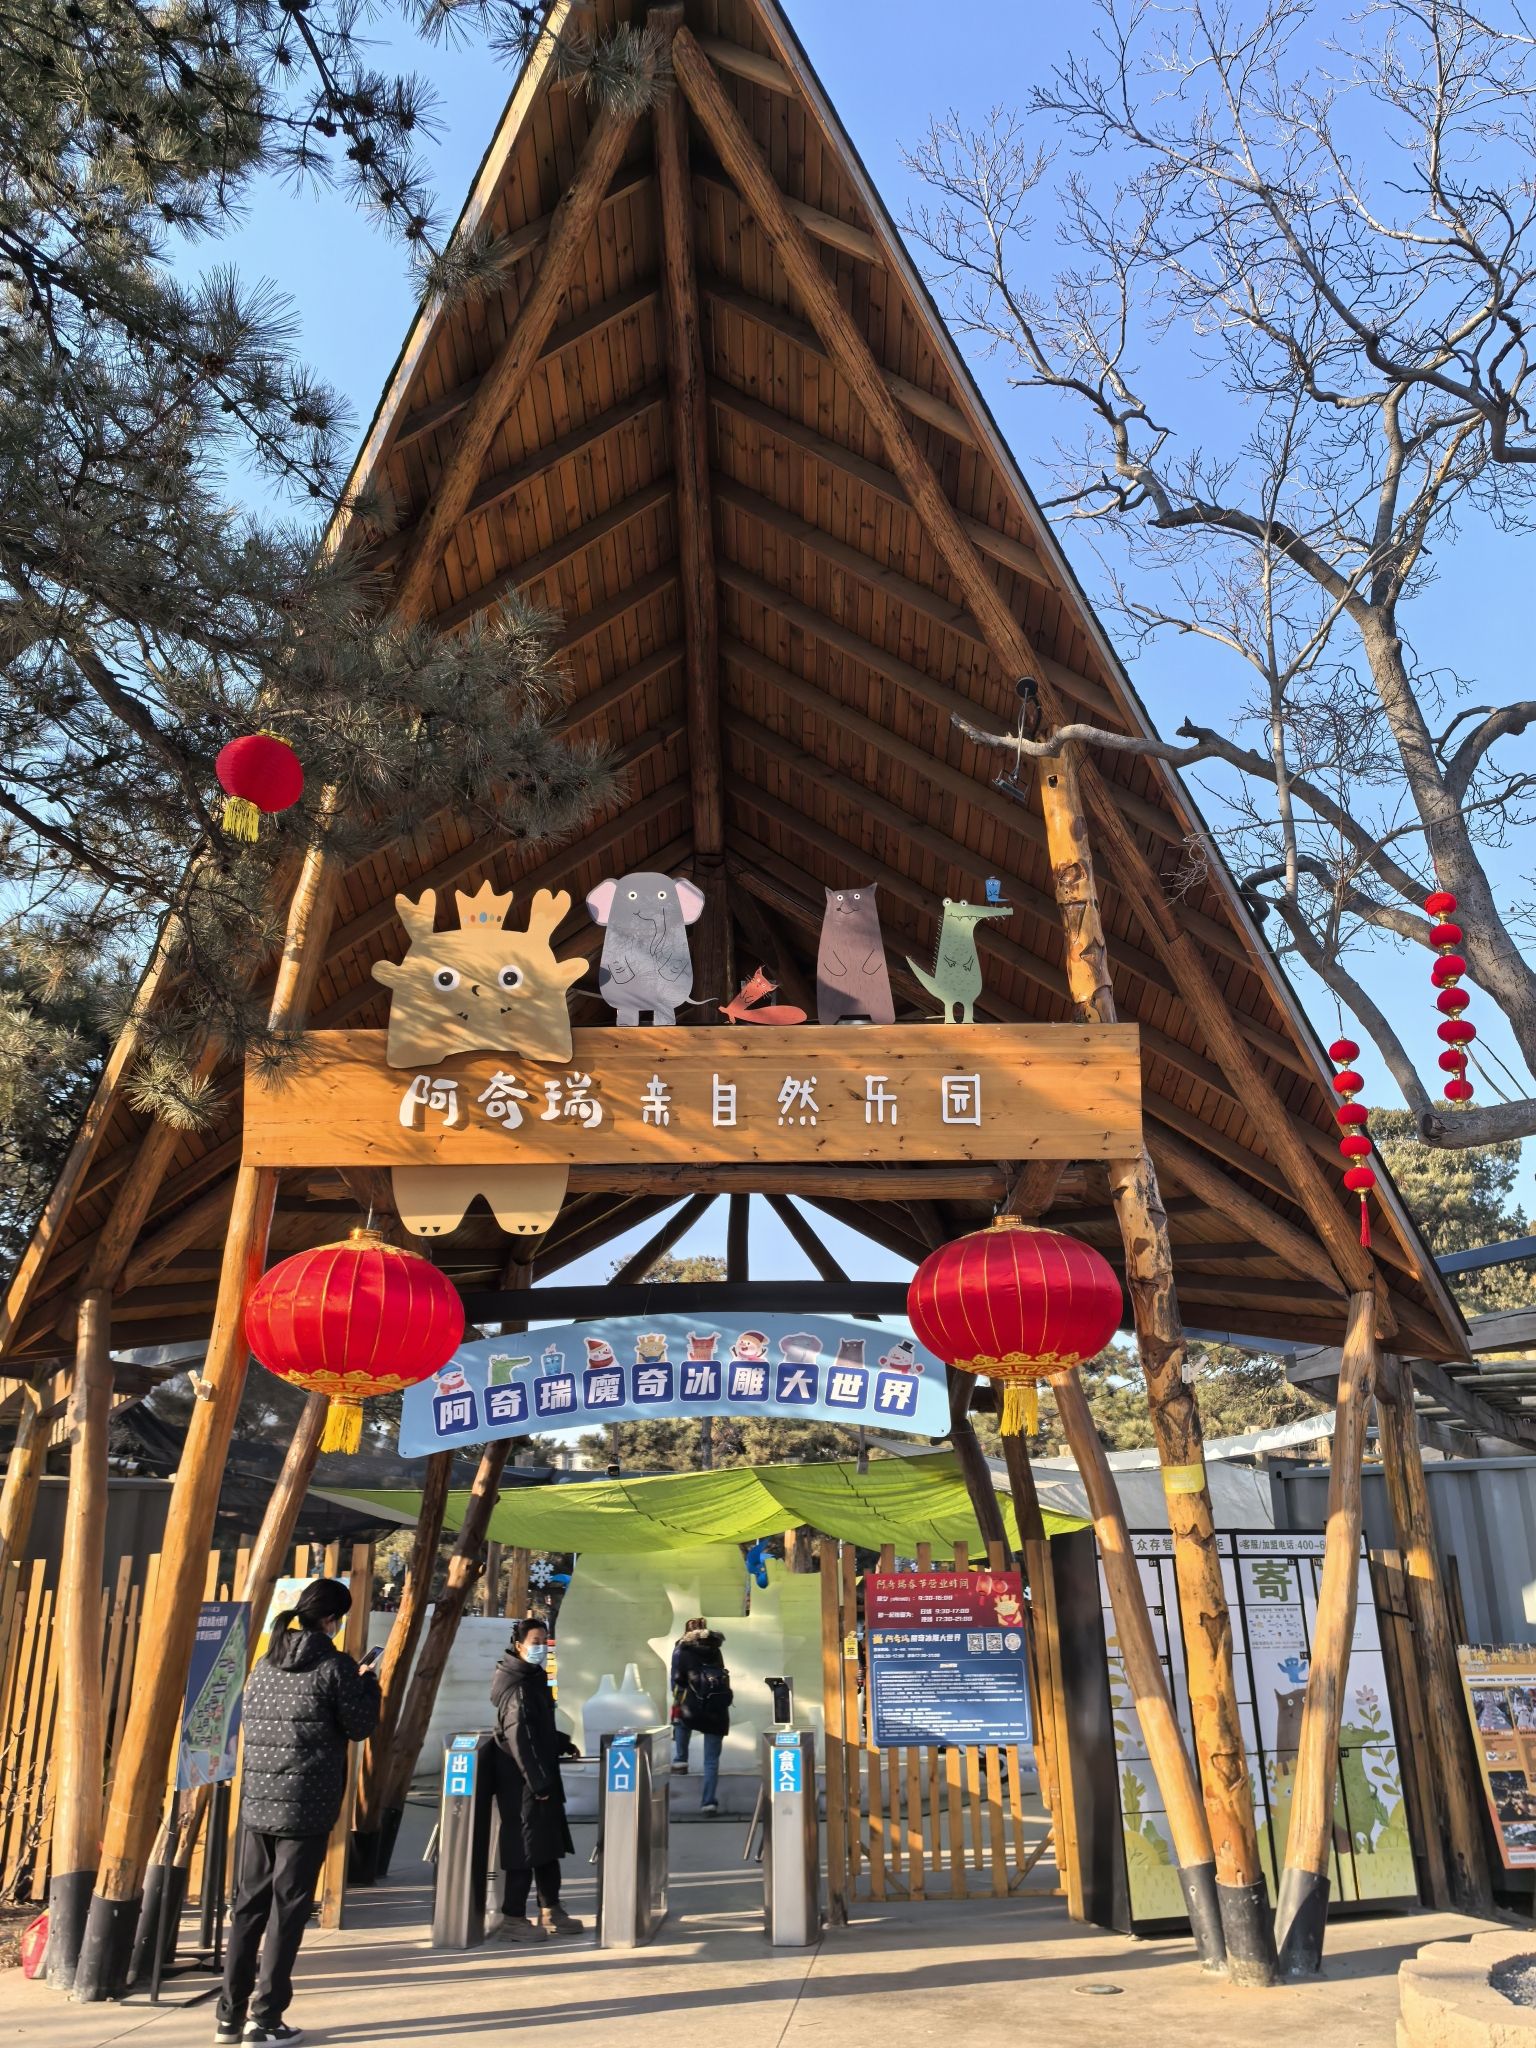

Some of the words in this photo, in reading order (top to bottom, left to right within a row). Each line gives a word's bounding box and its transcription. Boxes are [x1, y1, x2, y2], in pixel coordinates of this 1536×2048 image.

[438, 1366, 914, 1430] 阿奇瑞魔奇冰雕大世界
[876, 1578, 969, 1590] 阿奇瑞春节营业时间
[1251, 1560, 1293, 1602] 寄
[451, 1754, 468, 1794] 出口
[613, 1751, 630, 1791] 入口
[777, 1750, 796, 1792] 会员入口
